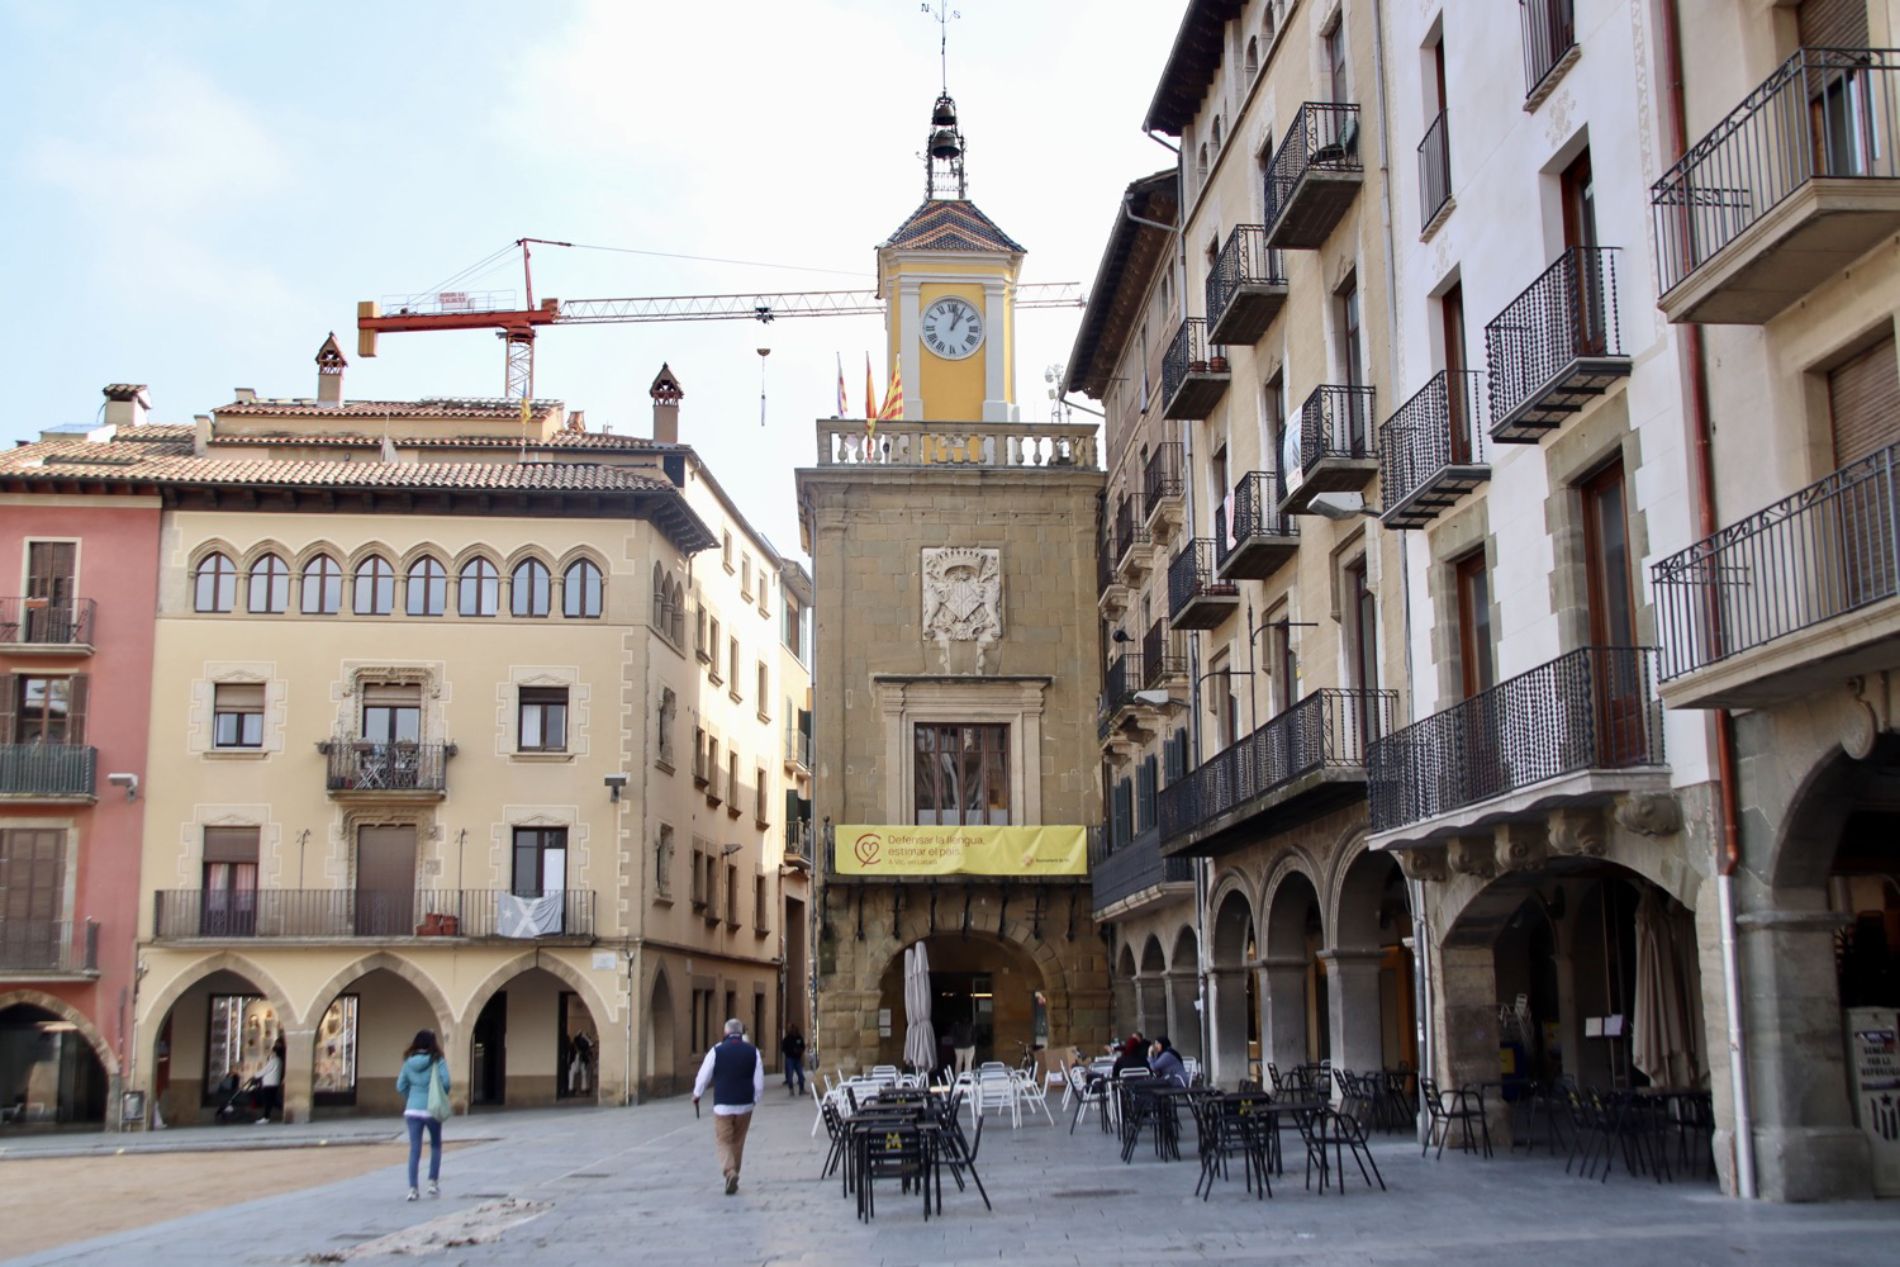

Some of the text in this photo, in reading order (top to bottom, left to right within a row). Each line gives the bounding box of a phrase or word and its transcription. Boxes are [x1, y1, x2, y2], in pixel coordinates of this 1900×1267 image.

[888, 835, 984, 848] Defensar la llengua,
[888, 846, 926, 856] estimar
[928, 846, 938, 856] el
